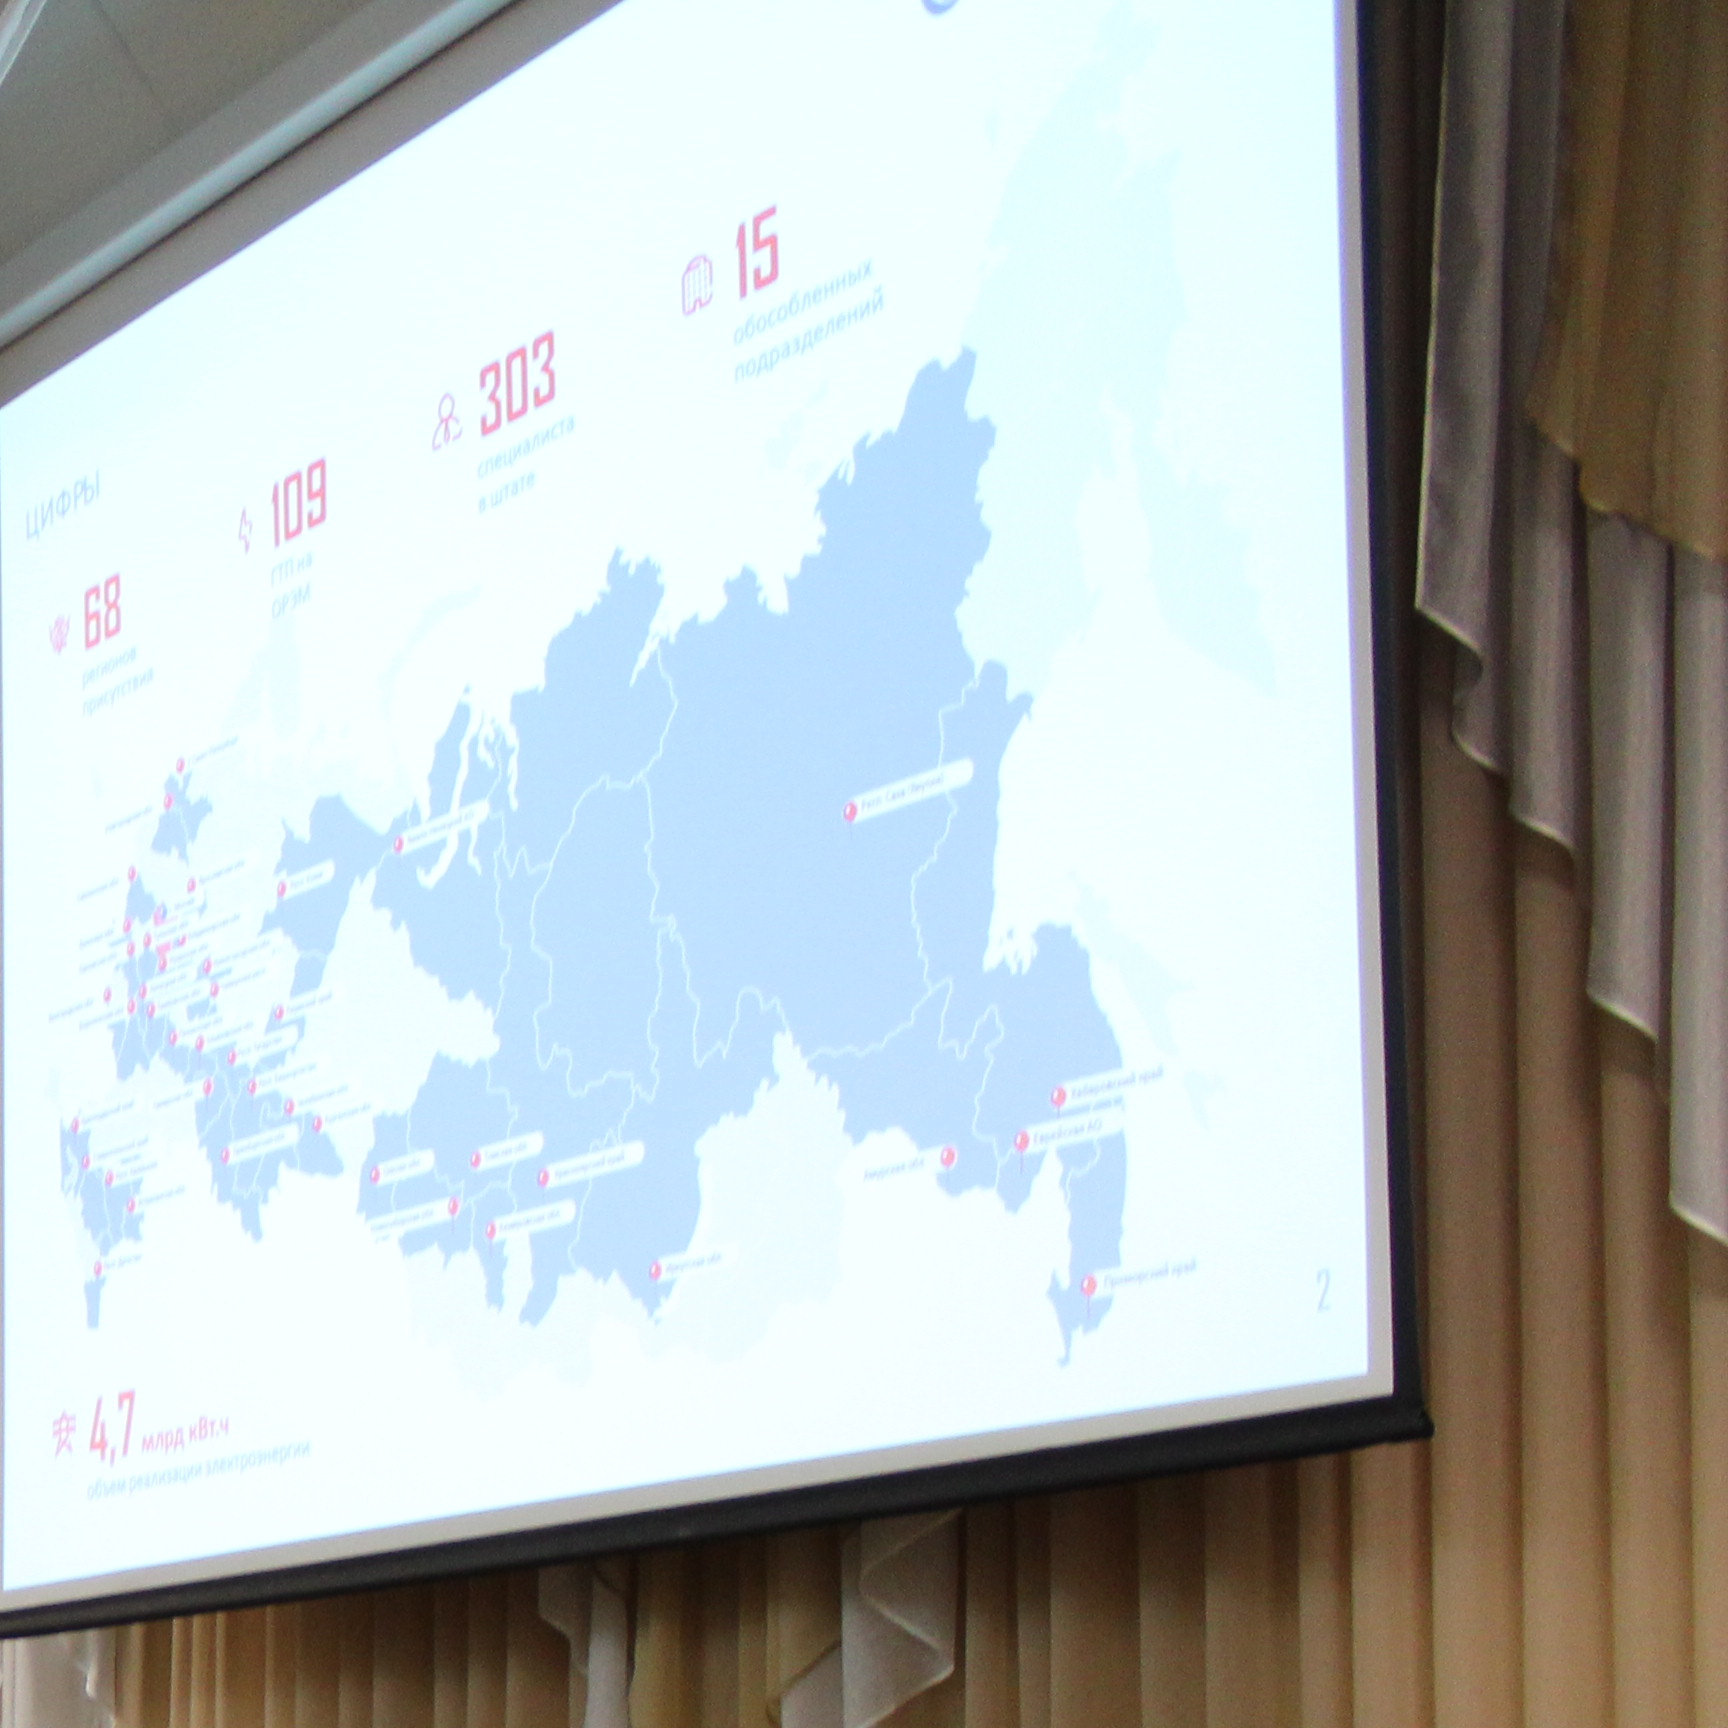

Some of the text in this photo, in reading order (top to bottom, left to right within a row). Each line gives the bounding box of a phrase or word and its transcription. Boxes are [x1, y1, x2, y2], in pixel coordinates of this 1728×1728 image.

[735, 204, 780, 301] 15
[733, 257, 874, 346] обособленных
[734, 283, 886, 384] подразделений
[479, 328, 557, 437] 303
[476, 414, 577, 481] специалиста
[25, 469, 101, 542] ЦИФРЫ
[271, 456, 328, 549] 109
[489, 471, 536, 508] штате
[271, 550, 313, 587] ГТП на
[271, 582, 311, 619] ОРЭМ
[84, 572, 123, 651] 68
[82, 646, 137, 692] регионов
[82, 667, 155, 719] присутствия
[1316, 1268, 1331, 1312] 2
[89, 1388, 136, 1467] 4,7
[141, 1426, 185, 1455] млрд
[86, 1439, 312, 1501] объем реализации электроэнергии
